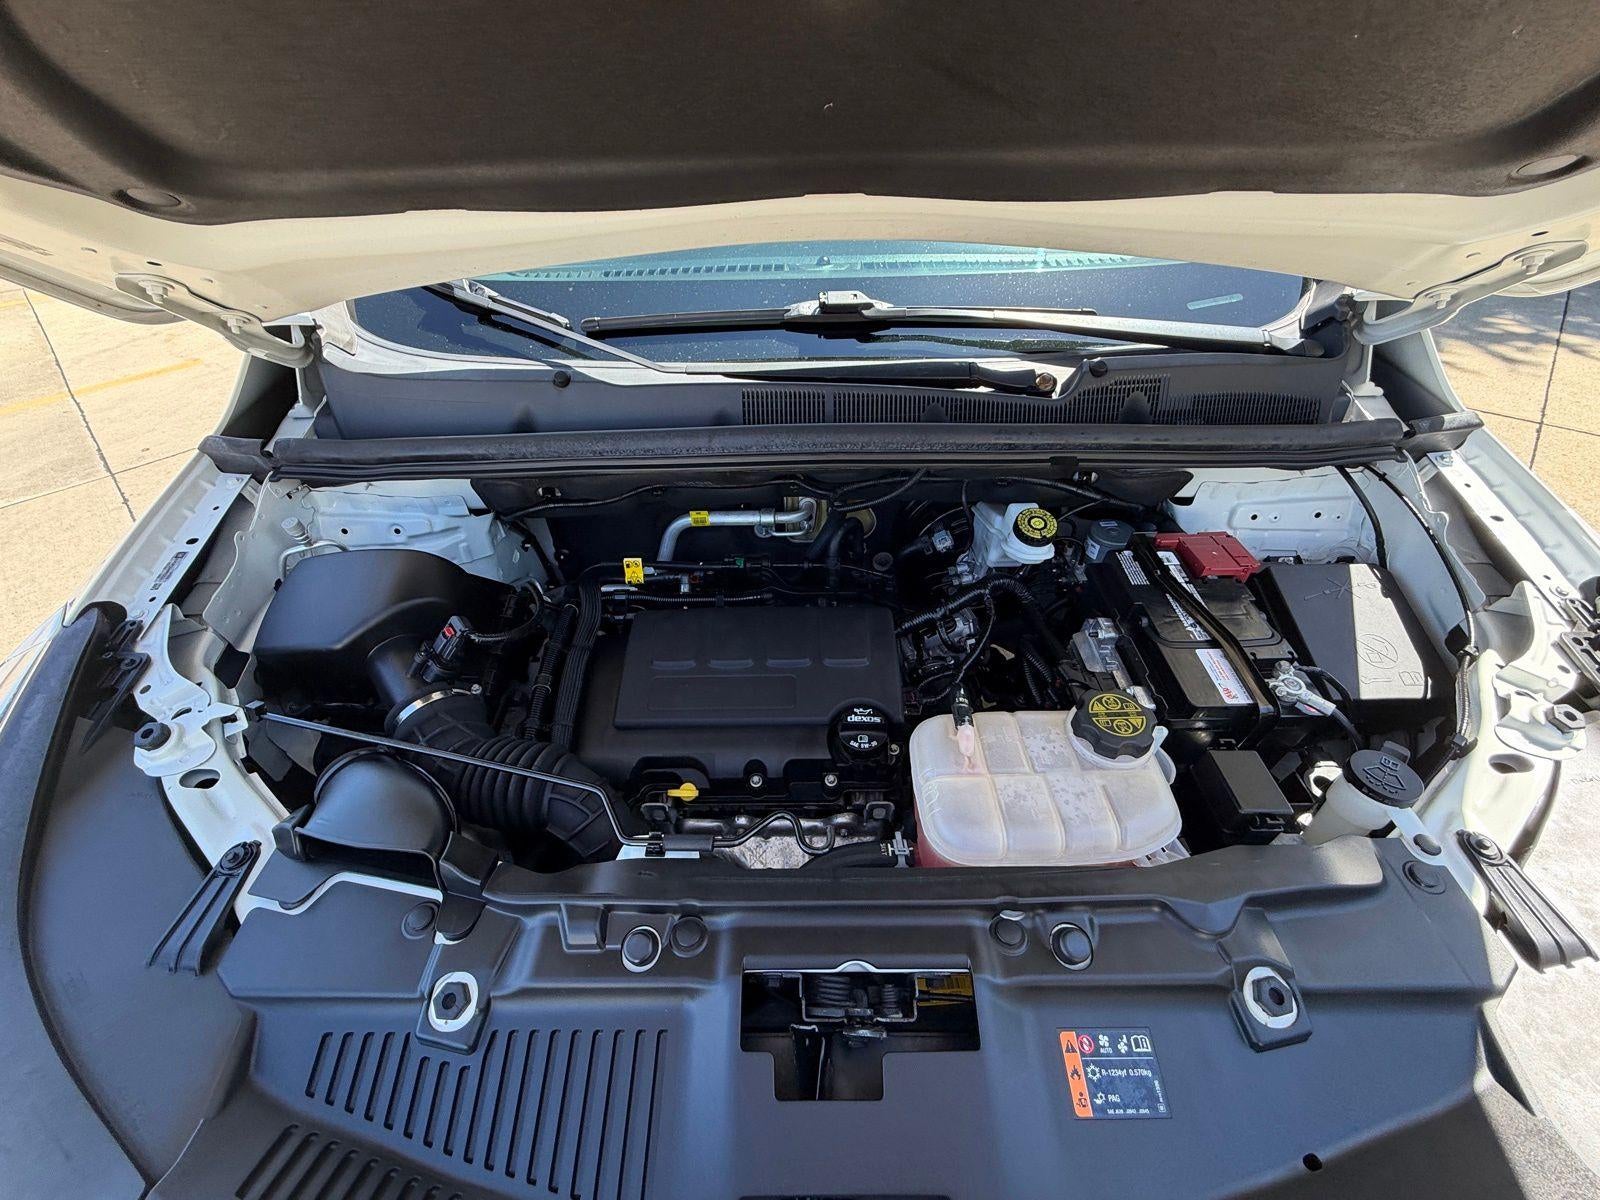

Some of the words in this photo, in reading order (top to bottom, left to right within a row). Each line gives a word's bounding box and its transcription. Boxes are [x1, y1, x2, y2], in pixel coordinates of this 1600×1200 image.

[847, 714, 881, 723] dexos
[1101, 1068, 1127, 1077] R-1234yf
[1128, 1068, 1152, 1077] 0.570kg
[1108, 1094, 1120, 1102] PAG
